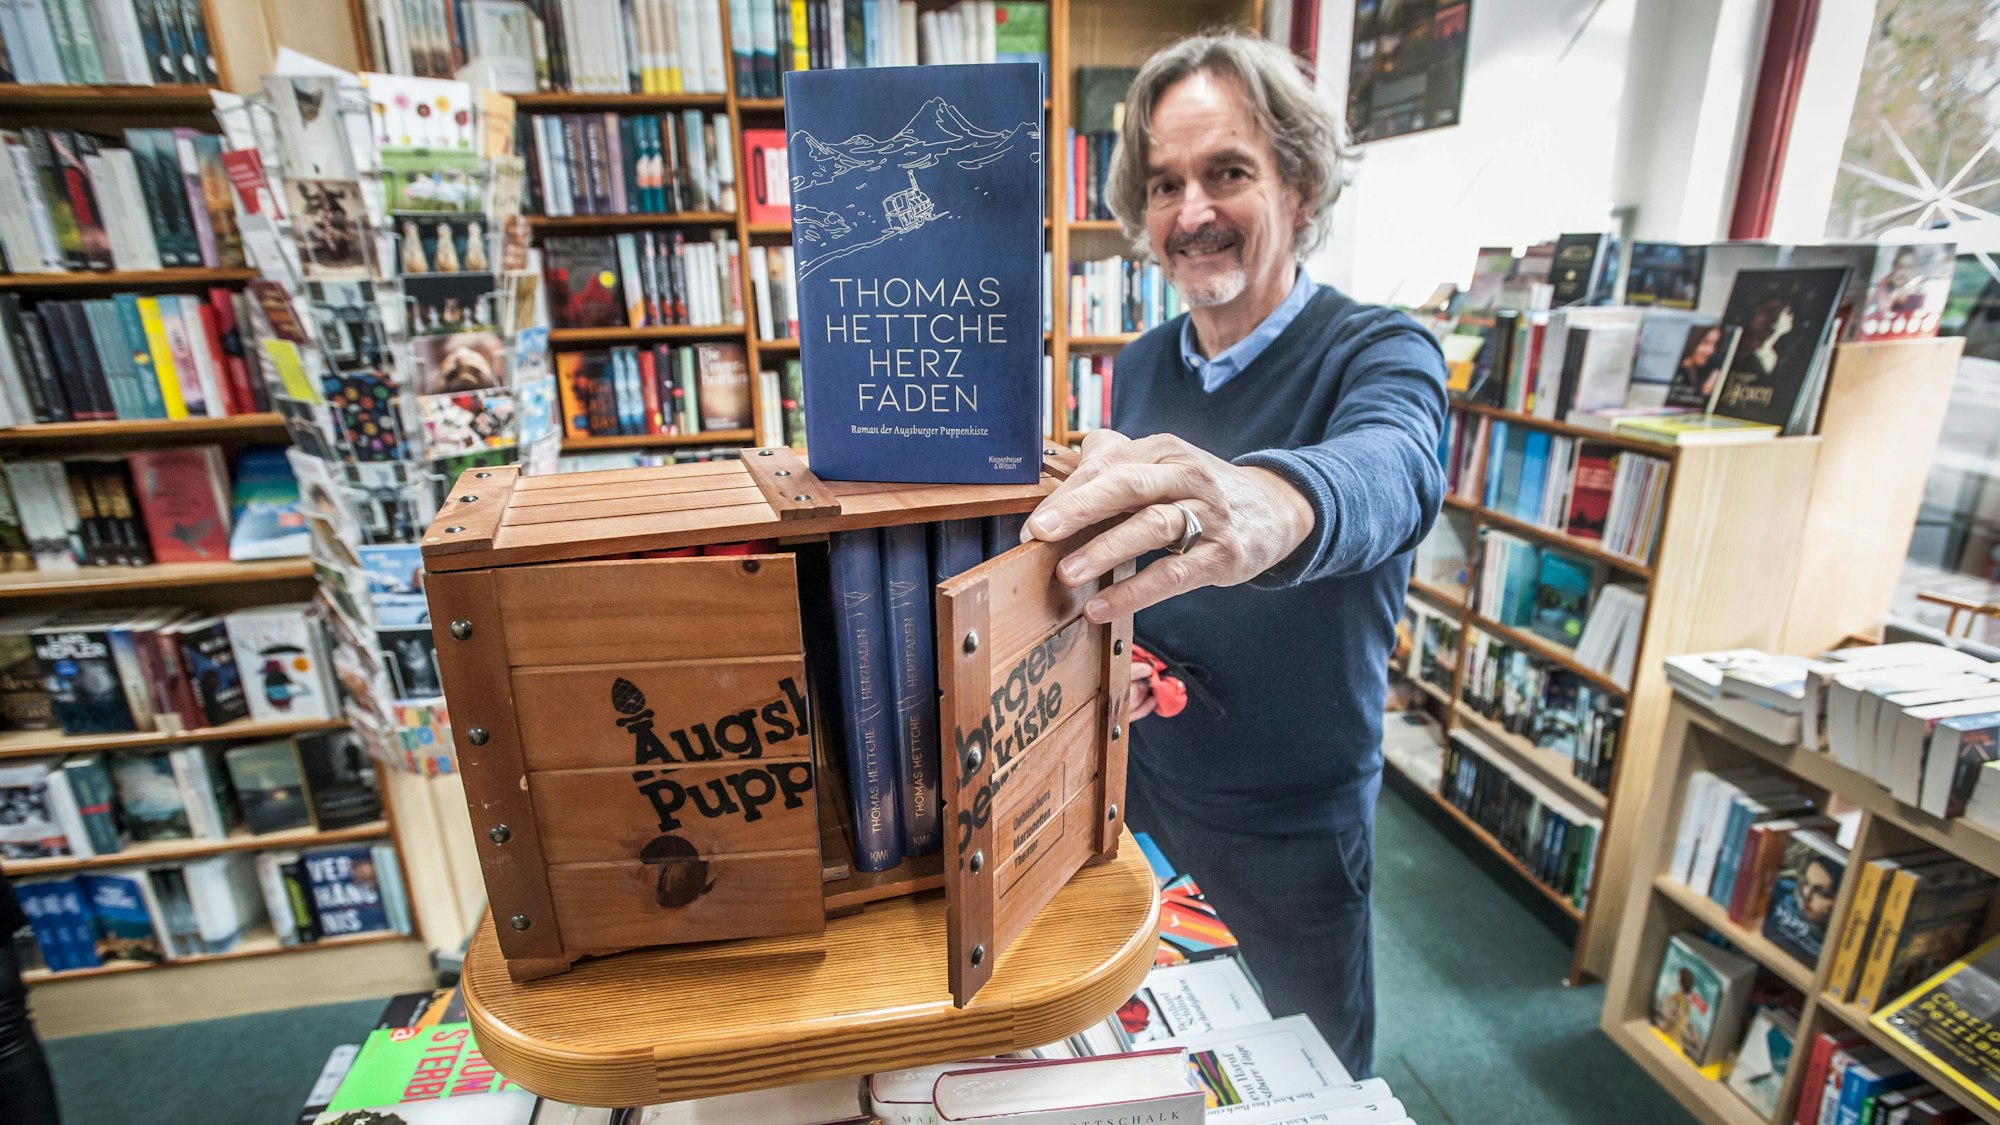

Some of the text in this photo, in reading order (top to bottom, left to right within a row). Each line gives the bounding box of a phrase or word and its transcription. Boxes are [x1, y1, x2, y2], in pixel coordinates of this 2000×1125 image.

[829, 276, 1000, 308] THOMAS
[826, 313, 1008, 344] HETTCHE
[869, 348, 964, 378] HERZ
[858, 383, 978, 413] FADEN
[850, 424, 989, 439] Roman der Augsburger Puppenkiste
[857, 628, 872, 700] HERZFADEN
[904, 617, 918, 688] HERZFADEN
[865, 727, 883, 835] THOMAS HETTCHE
[909, 714, 924, 819] THOMAS HETTCHE
[399, 1029, 470, 1104] STERB
[1242, 1084, 1260, 1101] ent
[1250, 1068, 1275, 1099] stbare
